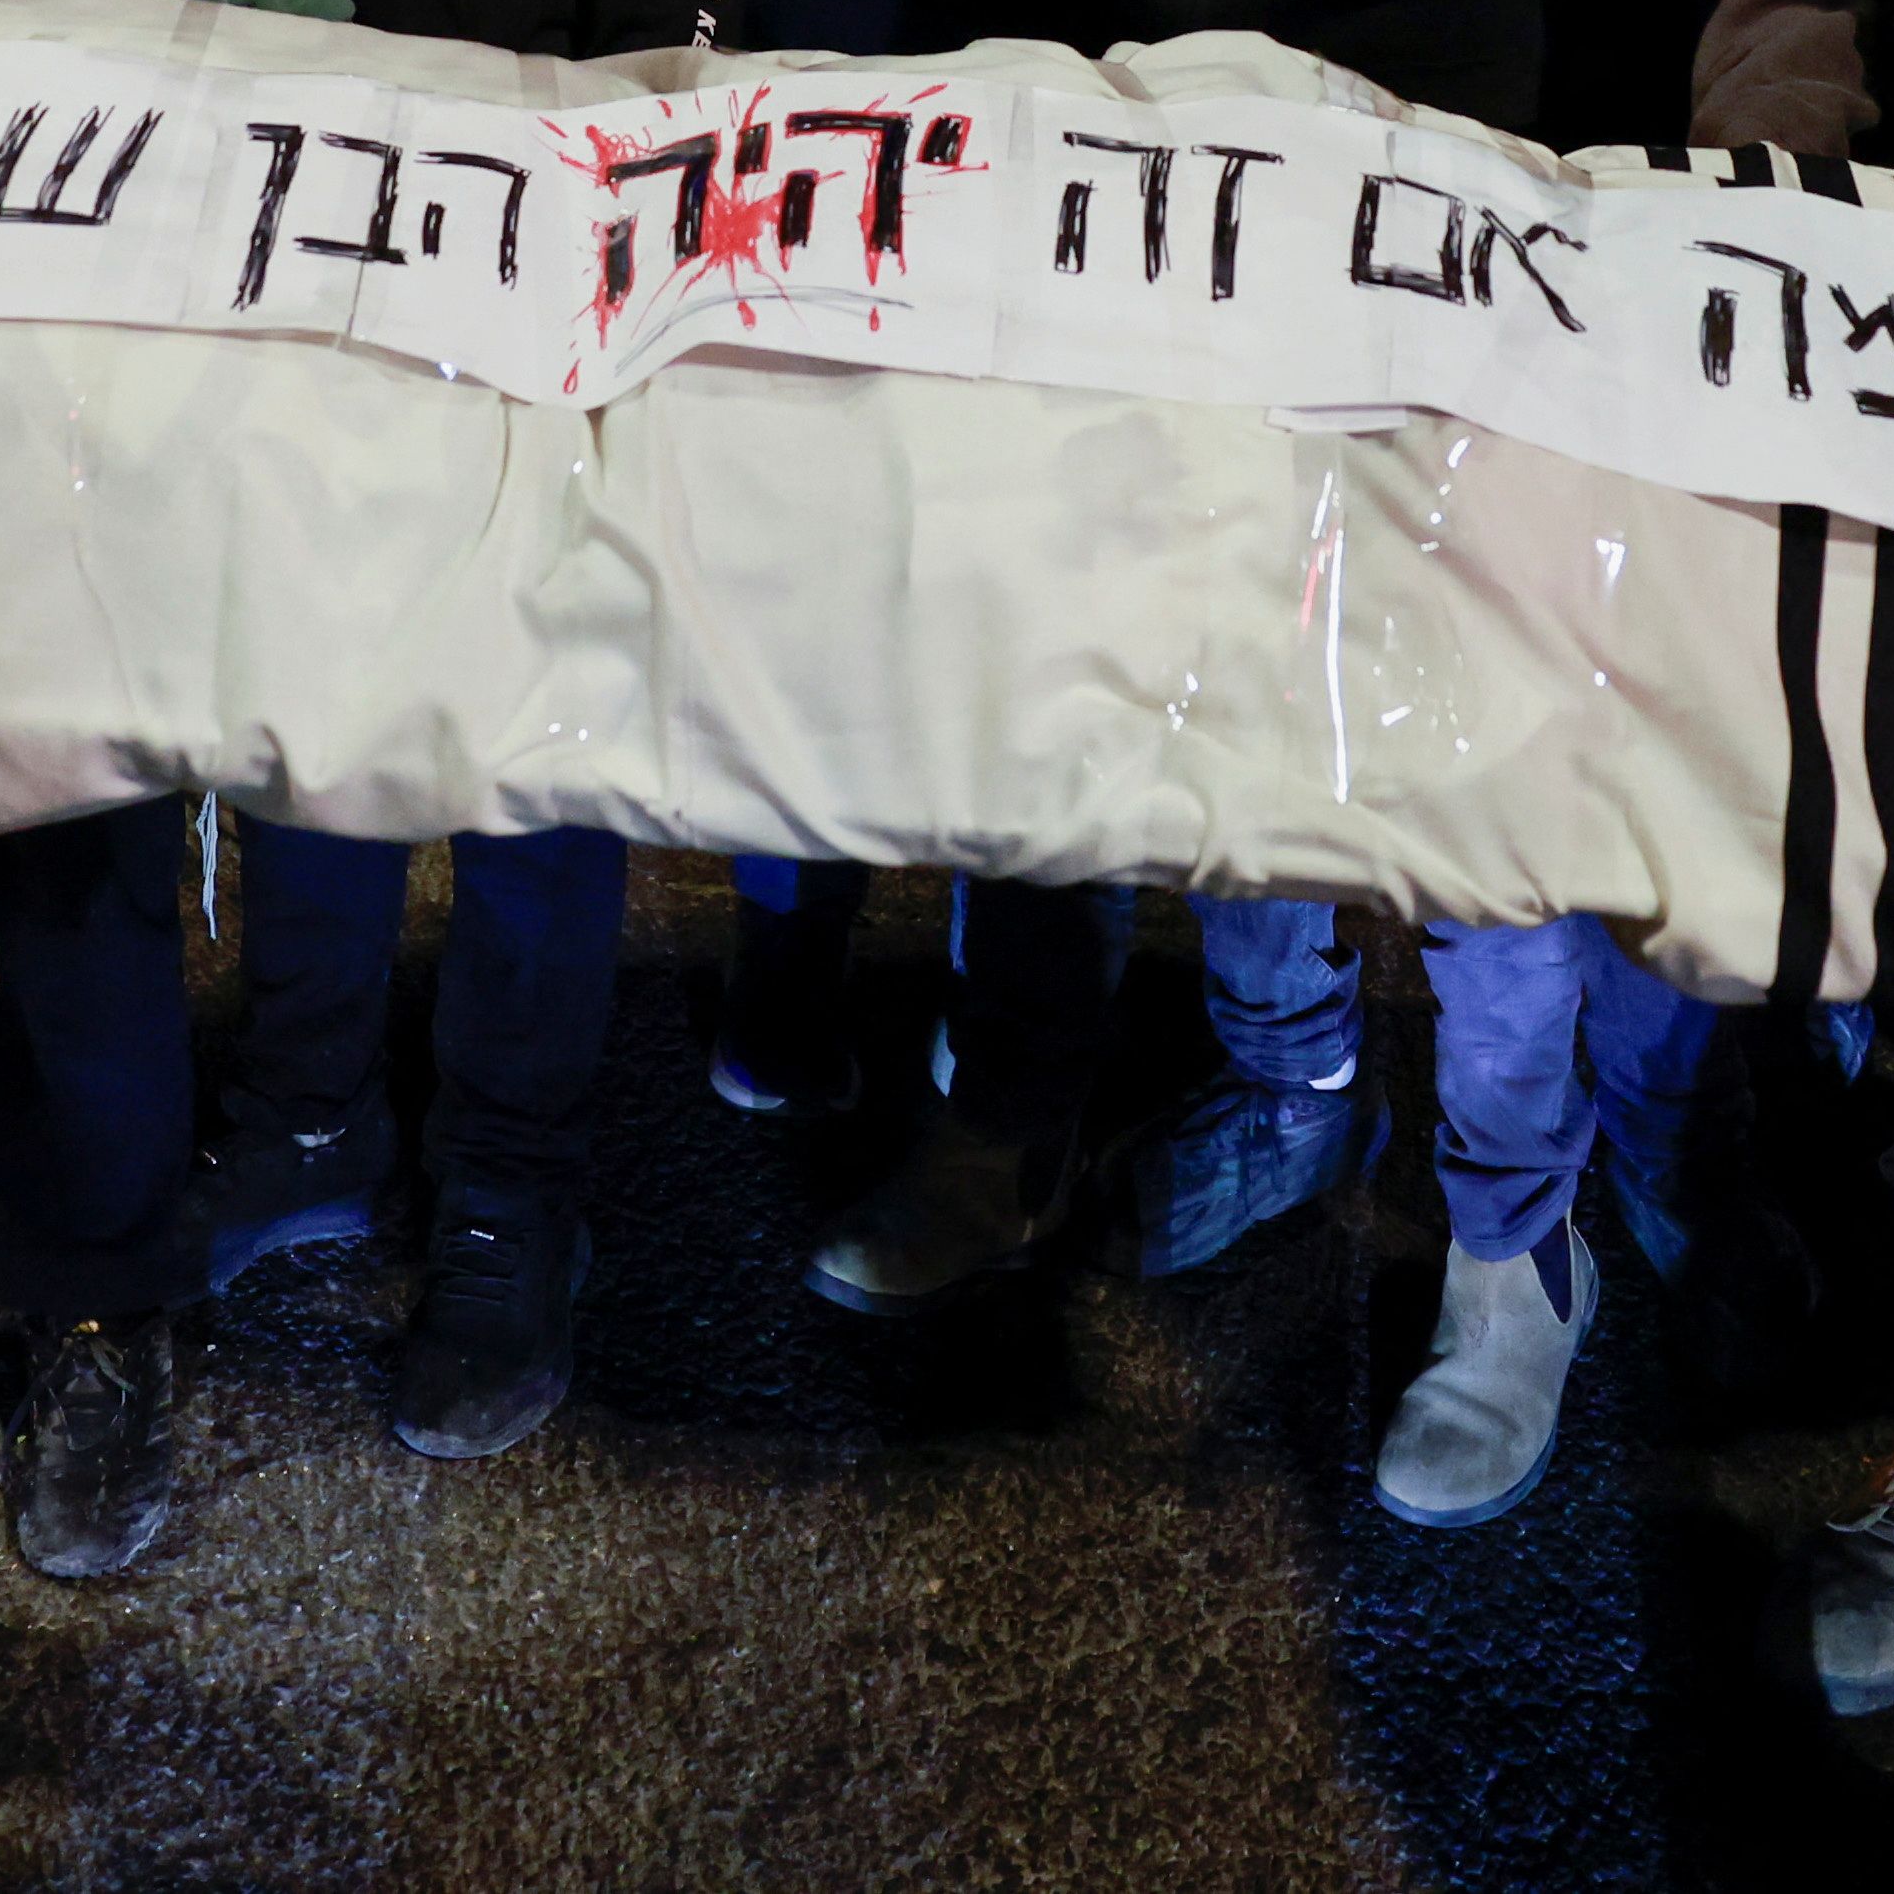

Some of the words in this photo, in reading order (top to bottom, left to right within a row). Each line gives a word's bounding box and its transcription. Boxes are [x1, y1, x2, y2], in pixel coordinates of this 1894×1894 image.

[230, 122, 532, 313] הבן
[596, 109, 974, 314] יהיה
[1056, 131, 1286, 302] זה
[1346, 172, 1588, 333] אם
